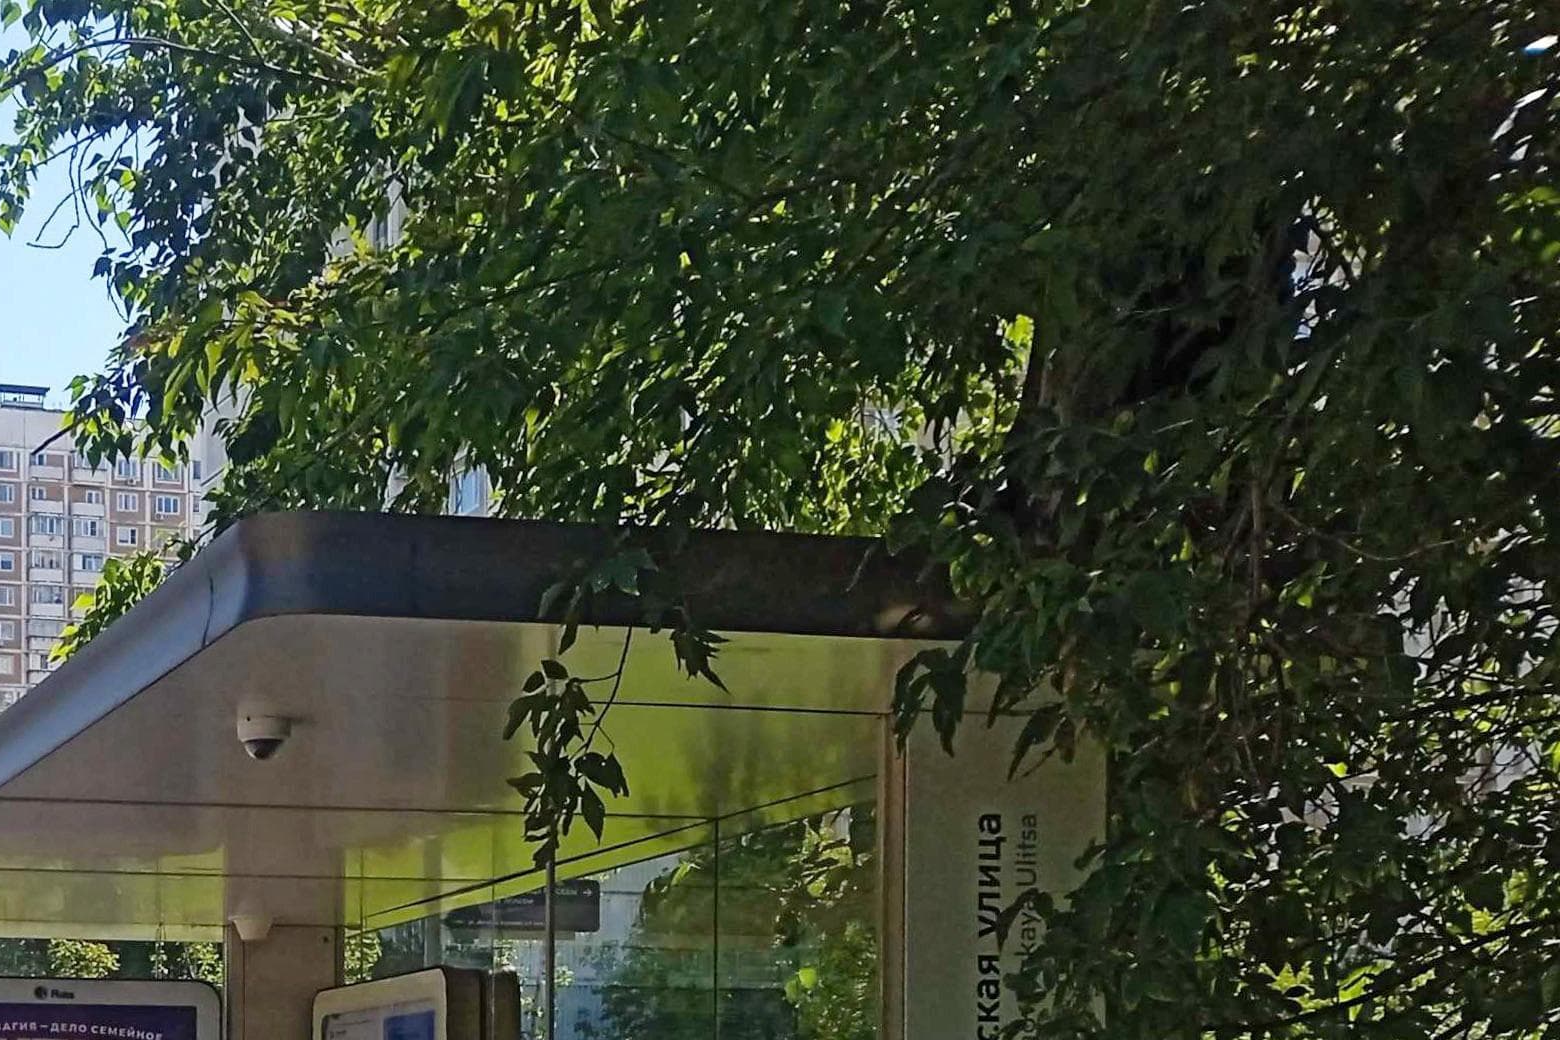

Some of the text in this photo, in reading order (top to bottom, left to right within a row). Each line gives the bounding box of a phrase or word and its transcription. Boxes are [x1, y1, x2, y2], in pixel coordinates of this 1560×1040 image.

[977, 813, 1007, 938] улица
[1014, 813, 1038, 887] Ulitsa
[50, 1022, 87, 1033] ДЕЛО
